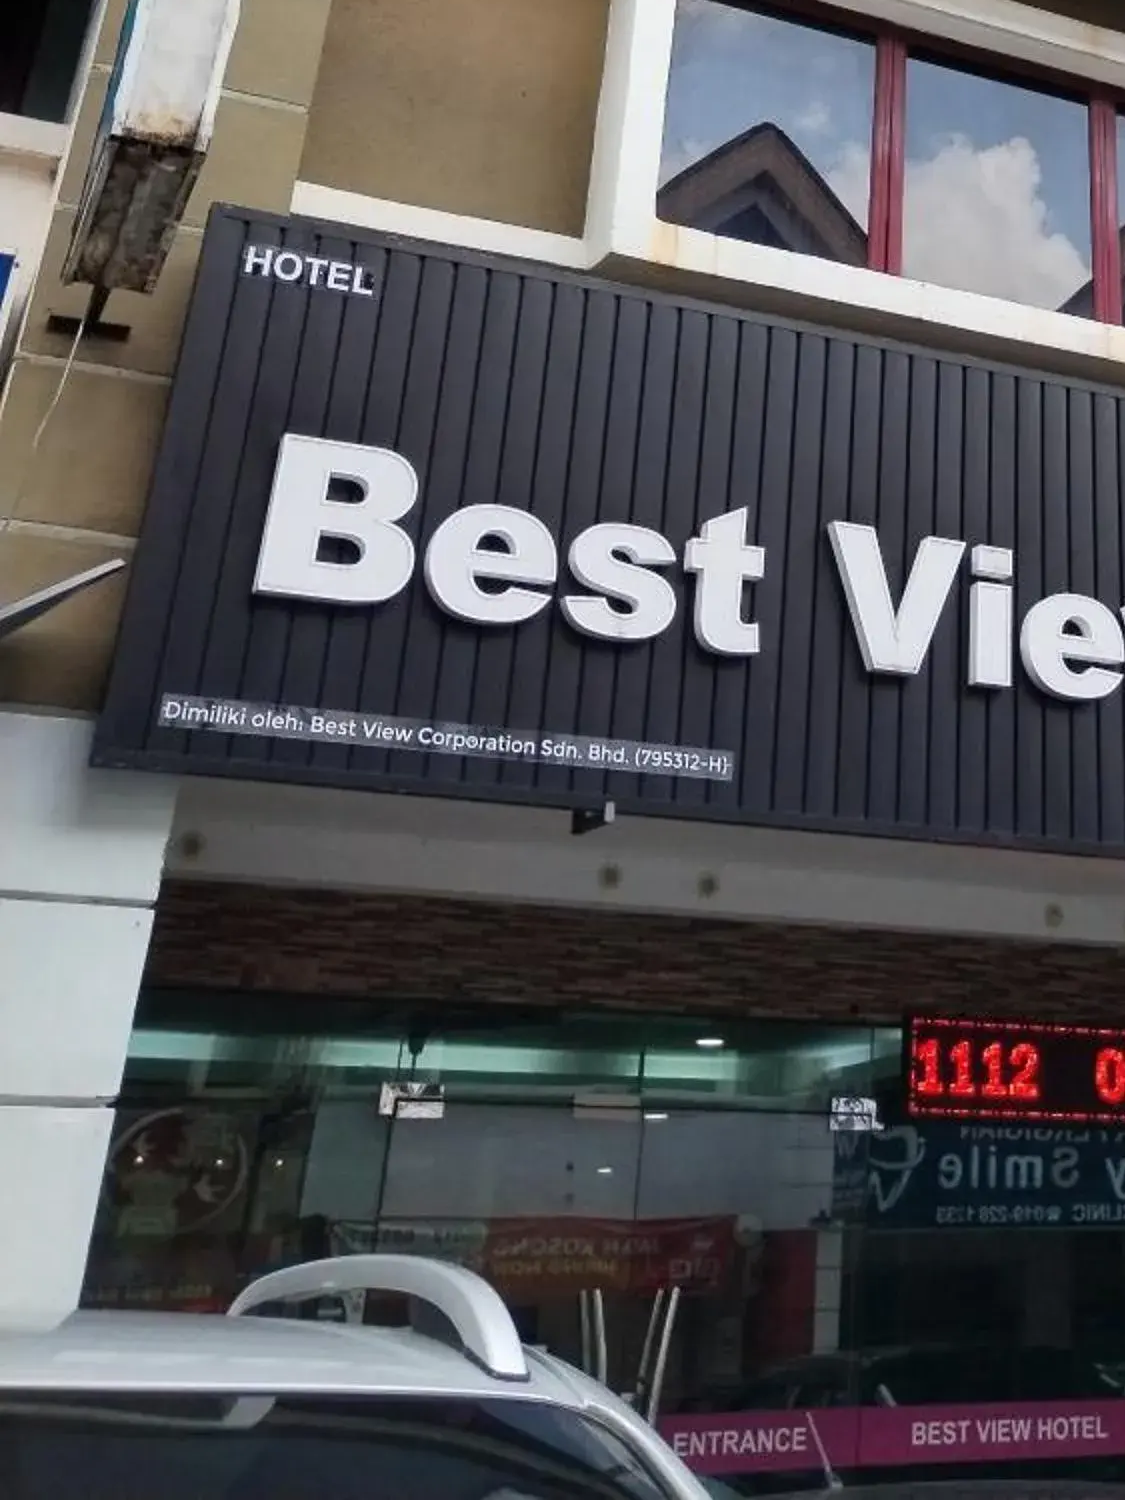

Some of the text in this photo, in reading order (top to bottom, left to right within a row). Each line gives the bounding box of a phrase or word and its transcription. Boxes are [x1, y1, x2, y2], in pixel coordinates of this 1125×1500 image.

[243, 244, 374, 296] HOTEL
[252, 432, 766, 659] Best
[163, 701, 247, 726] Dimiliki
[310, 716, 357, 738] Best
[362, 719, 413, 744] View
[417, 726, 536, 755] Corporation
[540, 738, 583, 760] Sdn.
[588, 743, 629, 764] Bhd.
[634, 748, 729, 774] (795312-H)
[915, 1039, 1041, 1099] 1112
[672, 1426, 808, 1457] ENTRANCE
[911, 1415, 1109, 1446] BEST VIEW HOTEL
